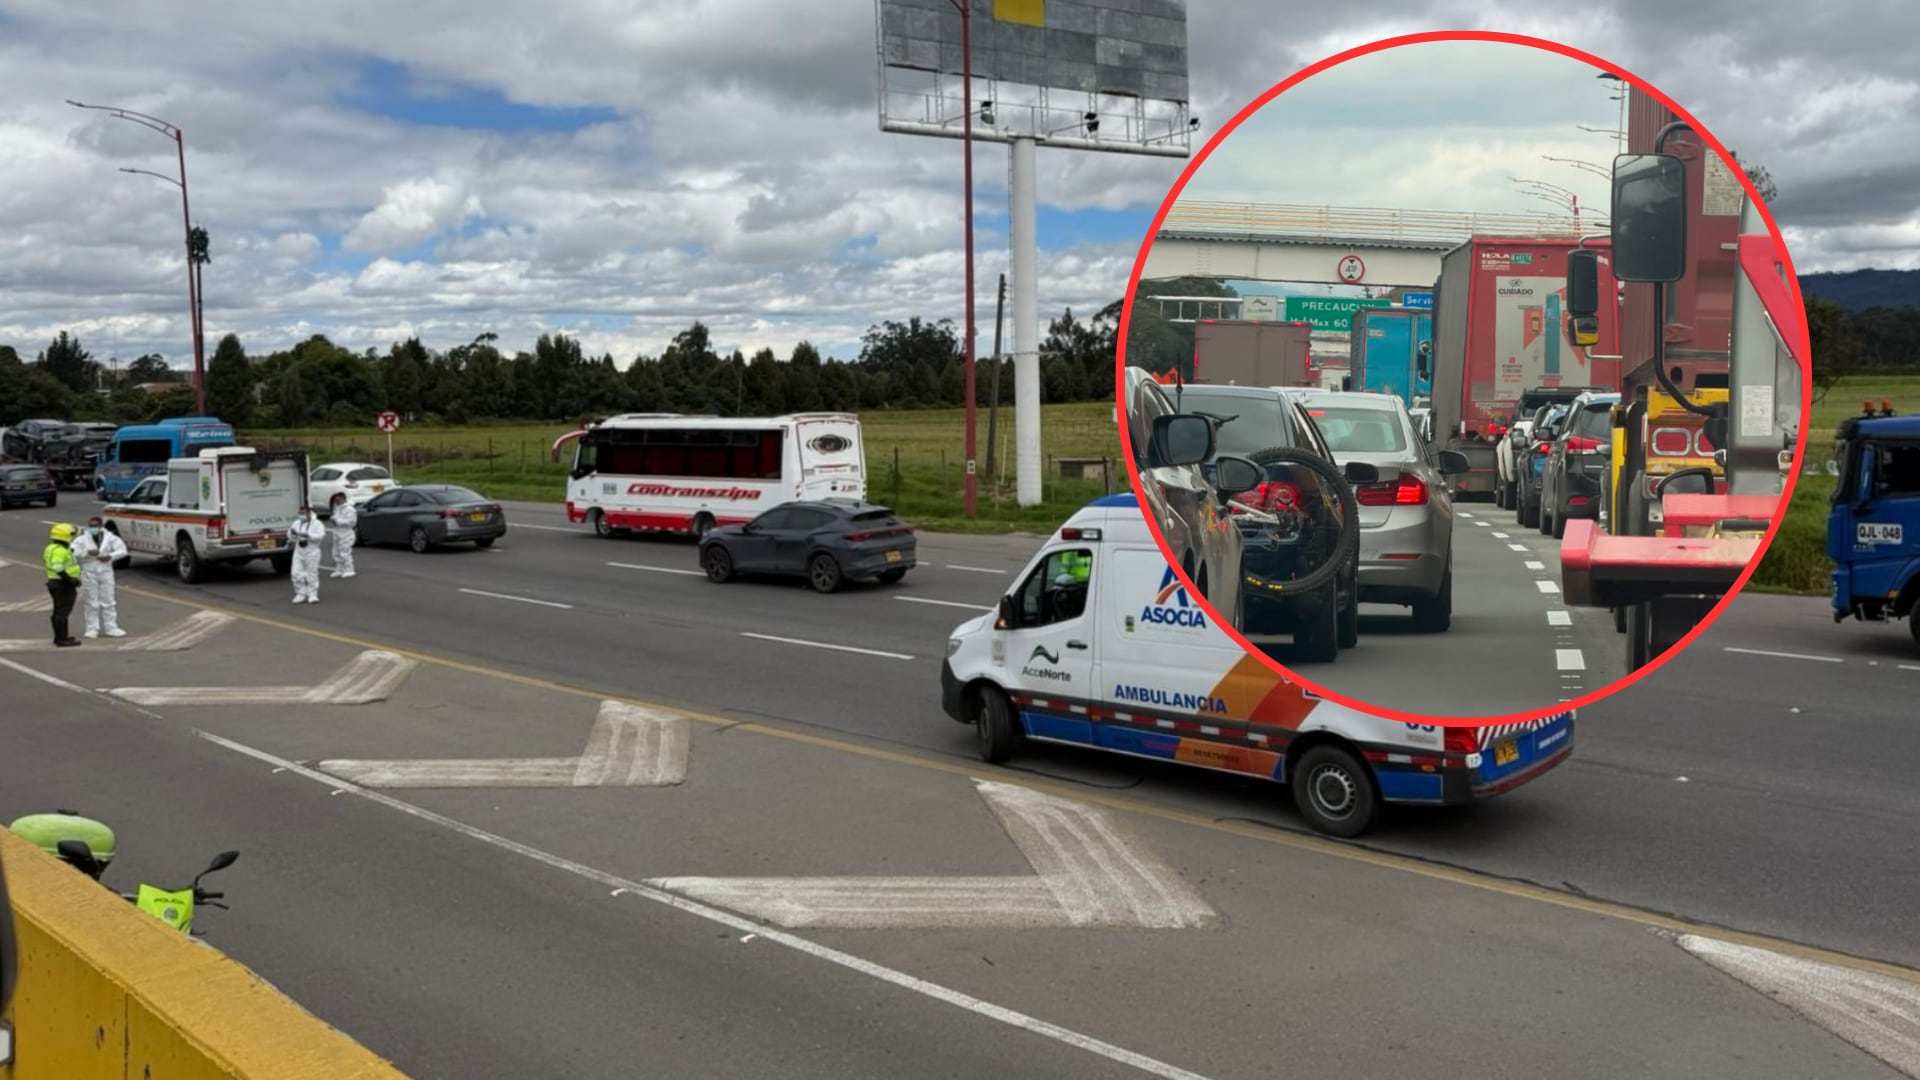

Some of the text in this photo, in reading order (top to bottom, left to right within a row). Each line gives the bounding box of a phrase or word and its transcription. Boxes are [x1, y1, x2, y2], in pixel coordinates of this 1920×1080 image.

[1406, 295, 1434, 305] Servi
[1335, 319, 1349, 328] 60
[627, 483, 762, 502] Cootranszipa
[1141, 606, 1206, 629] ASOCIA
[1022, 665, 1071, 682] AcceNorte
[1114, 683, 1228, 713] AMBULANCIA
